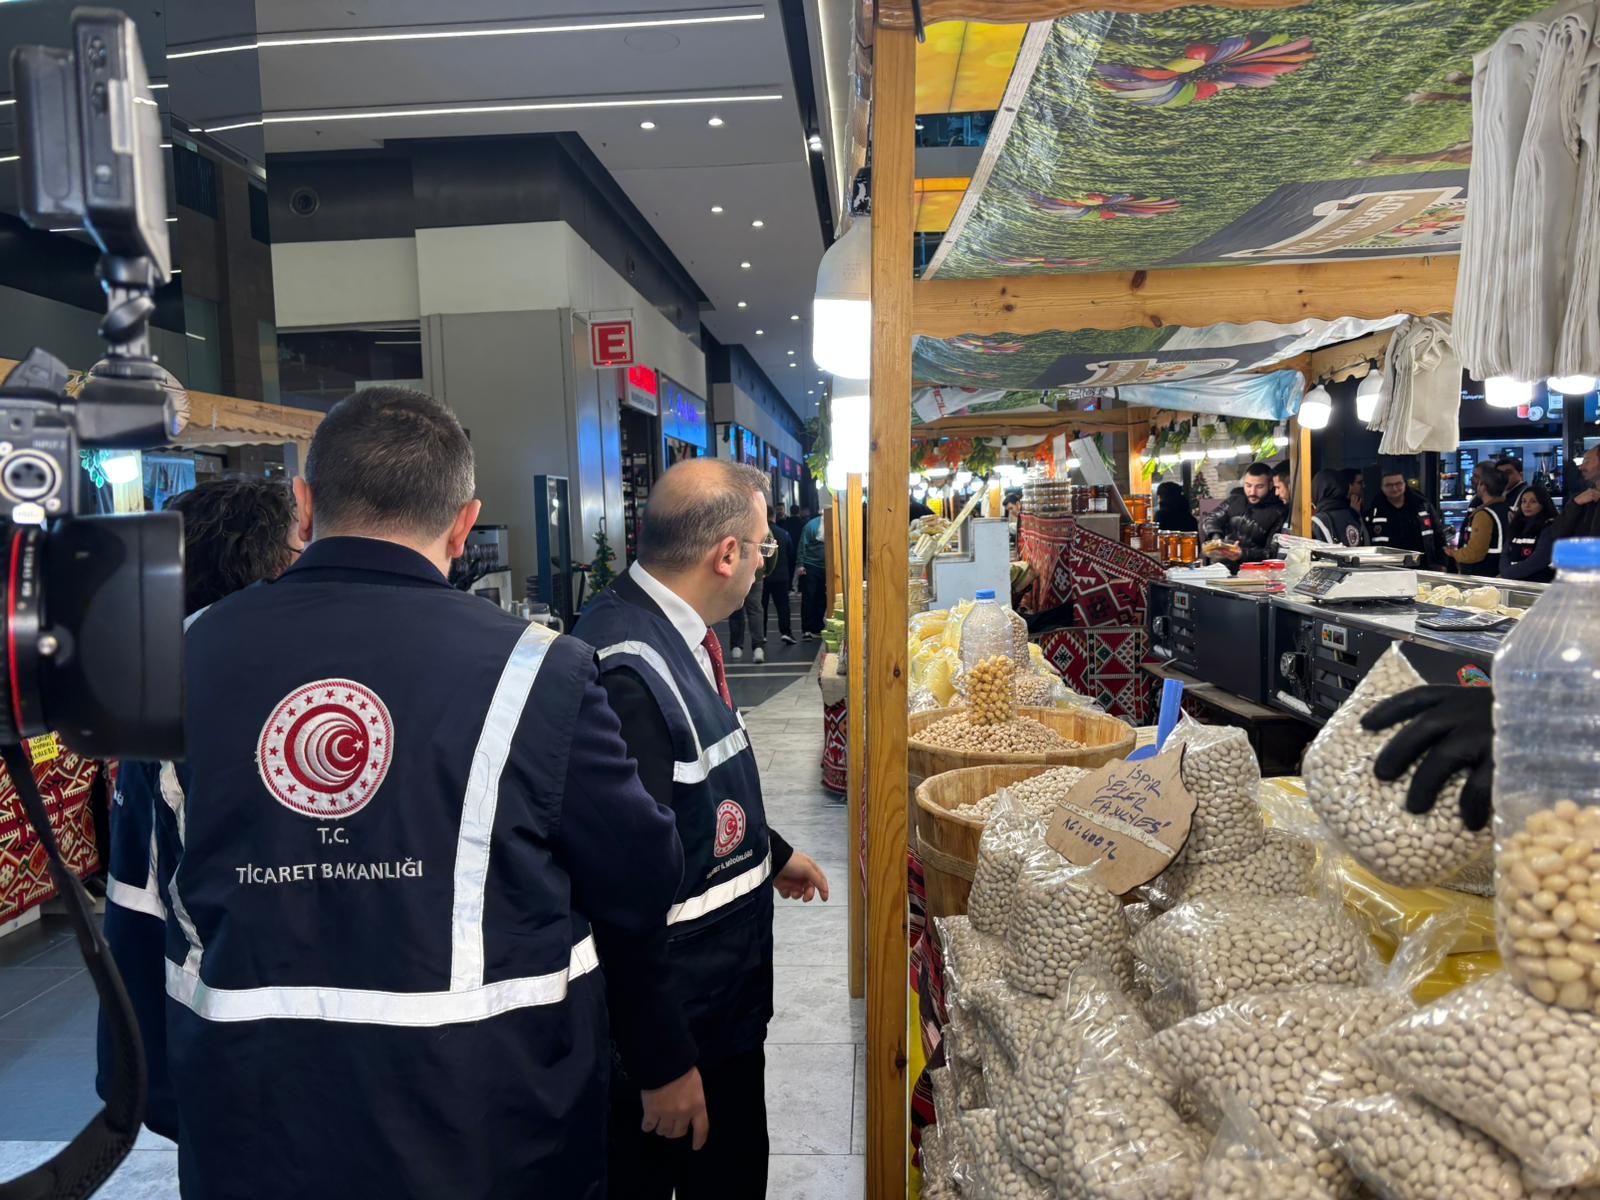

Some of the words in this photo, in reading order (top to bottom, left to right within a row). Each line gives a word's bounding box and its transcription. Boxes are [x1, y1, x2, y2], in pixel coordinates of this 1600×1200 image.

[598, 327, 628, 361] E
[317, 827, 349, 844] T.C.
[236, 863, 317, 885] TİCARET
[321, 857, 423, 880] BAKANLIĞI
